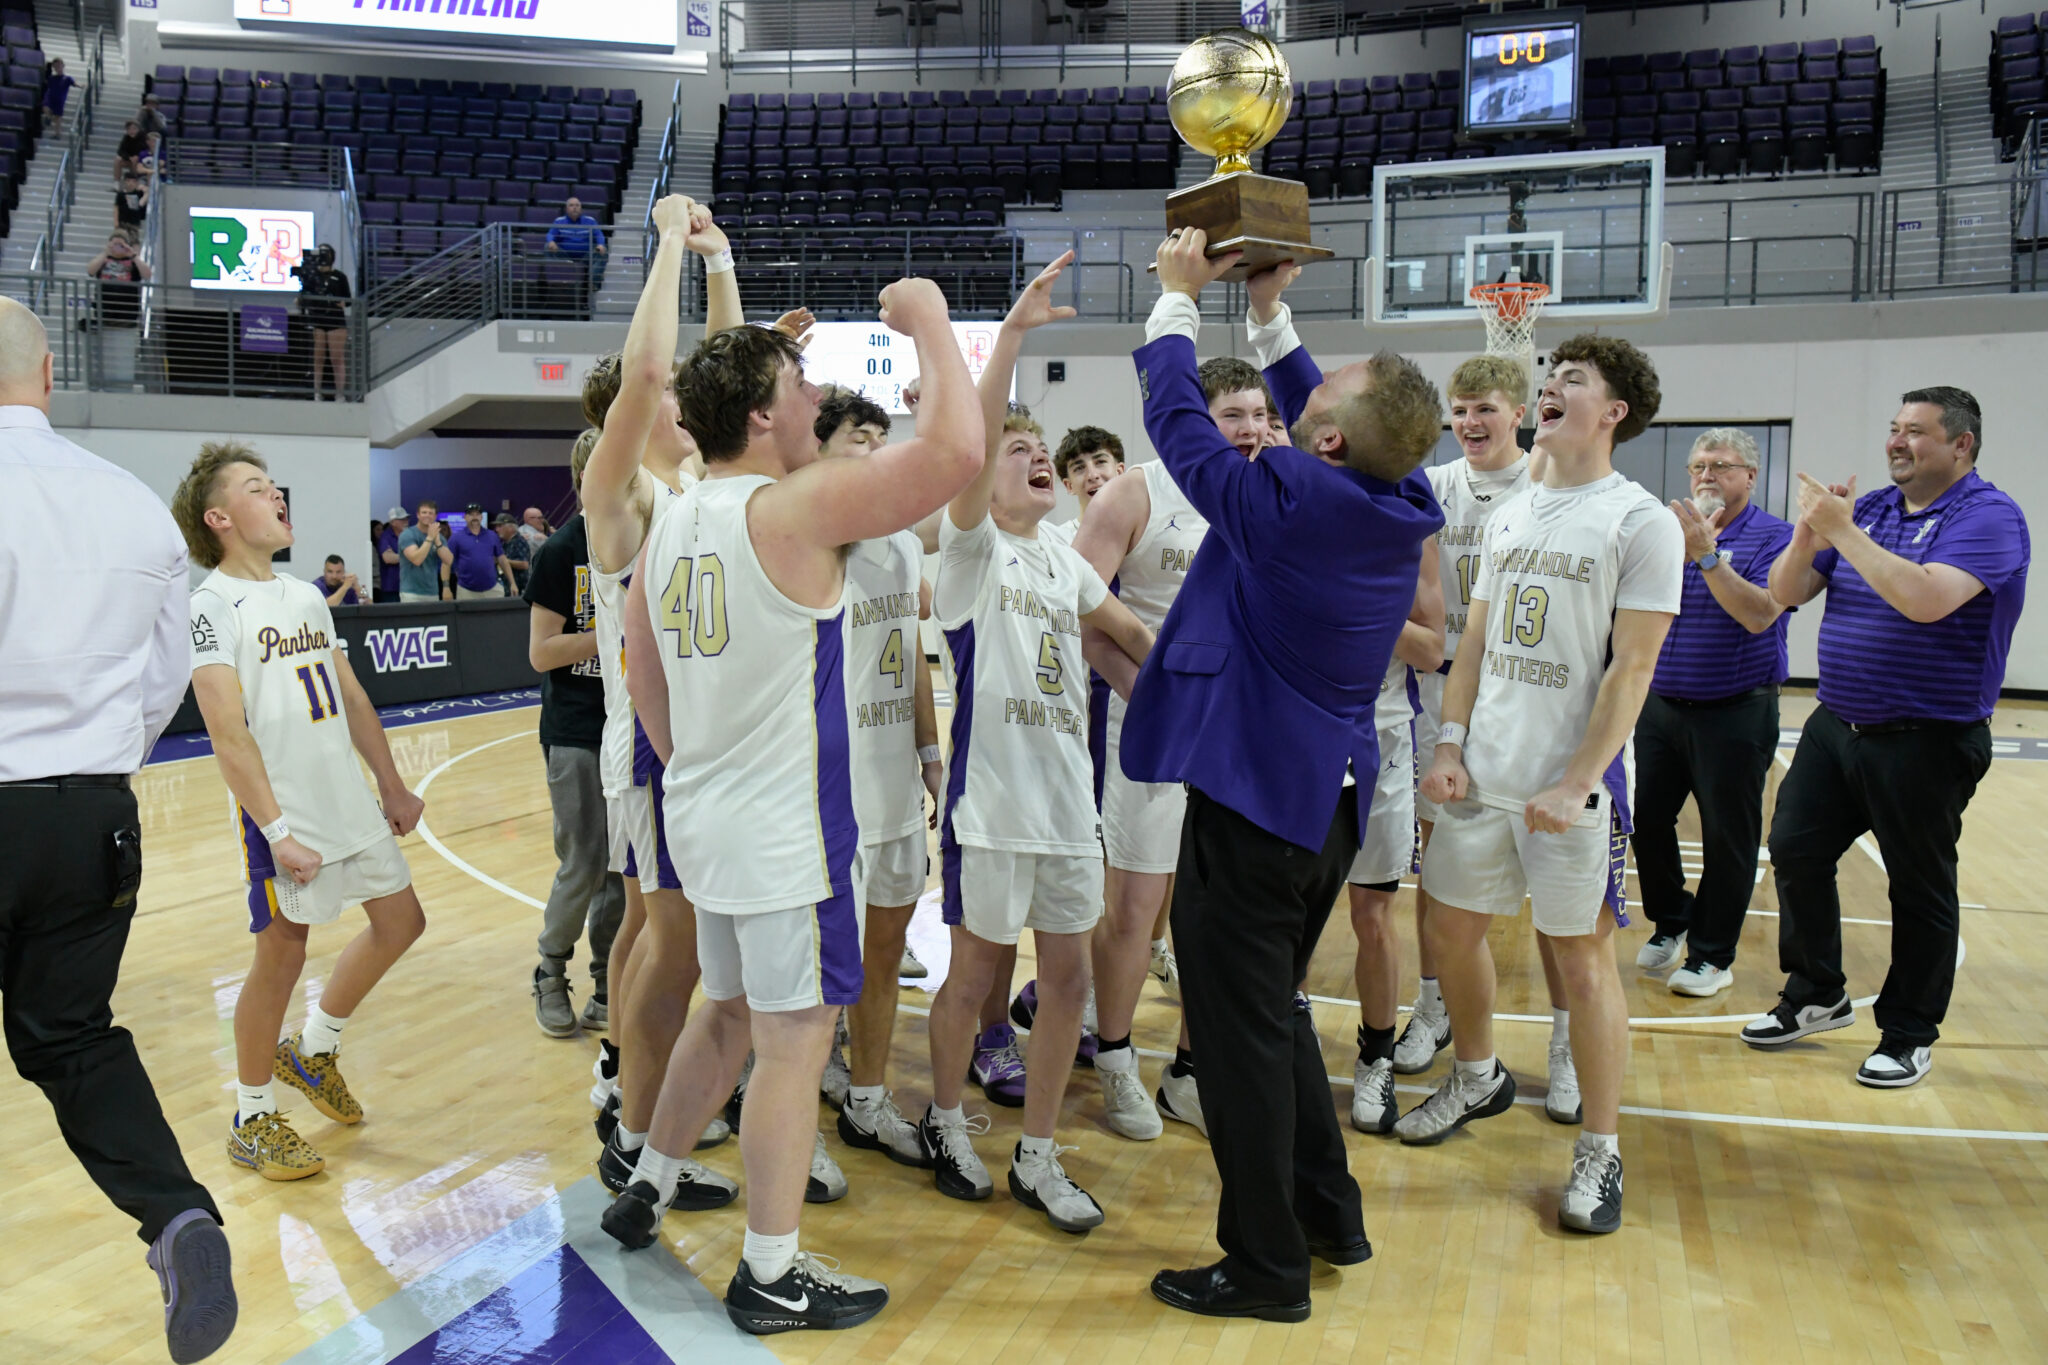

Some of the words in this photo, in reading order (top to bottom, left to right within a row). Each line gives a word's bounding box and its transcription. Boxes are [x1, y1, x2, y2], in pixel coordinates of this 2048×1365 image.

[691, 3, 708, 12] 116
[1245, 13, 1264, 24] 117
[690, 24, 709, 35] 115
[192, 216, 247, 280] R
[868, 333, 890, 347] 4th
[542, 364, 564, 380] EXIT
[867, 358, 892, 375] 0.0
[894, 383, 900, 394] 2
[894, 397, 900, 408] 2
[661, 552, 730, 658] 40
[1502, 583, 1550, 648] 13
[195, 644, 219, 654] HOOPS
[364, 625, 449, 674] WAC
[879, 628, 904, 689] 4
[1036, 631, 1064, 696] 5
[295, 660, 338, 723] 11
